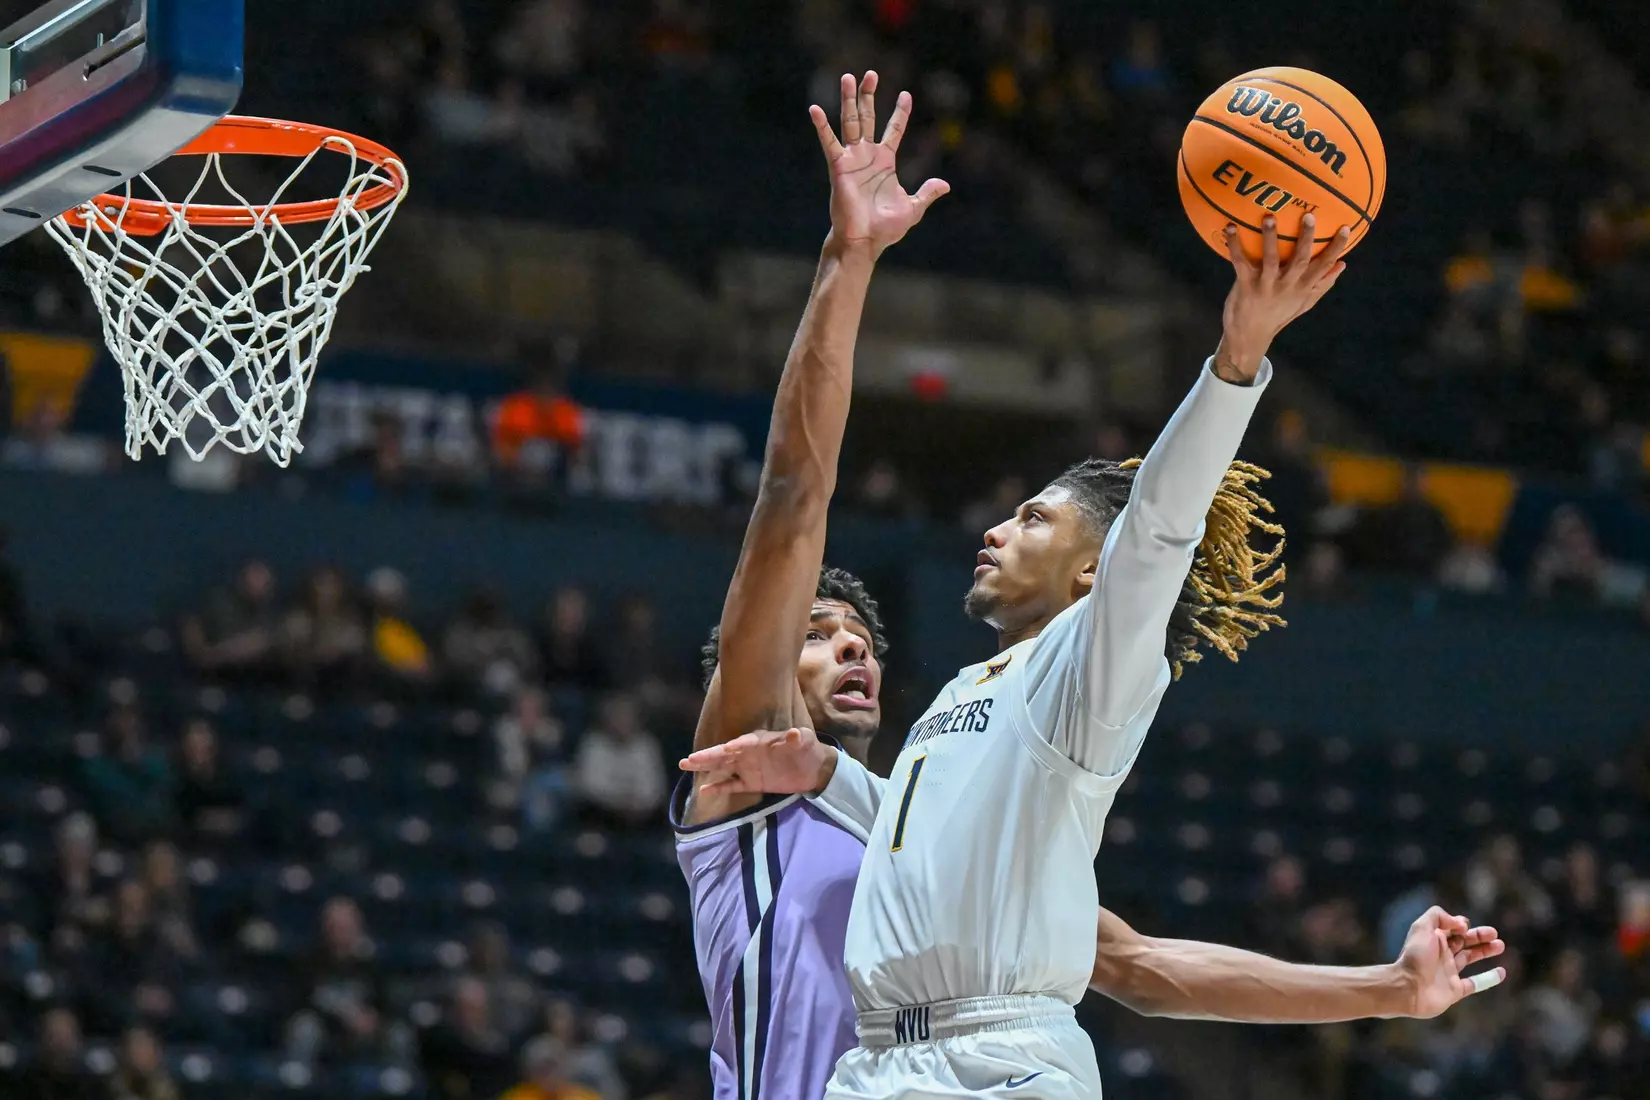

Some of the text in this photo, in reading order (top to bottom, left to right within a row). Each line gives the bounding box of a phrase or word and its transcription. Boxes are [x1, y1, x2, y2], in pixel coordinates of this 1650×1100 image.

[1226, 86, 1347, 175] Wilson
[1212, 159, 1319, 213] EVO NXT
[890, 754, 927, 853] 1
[895, 1006, 930, 1045] WVU
